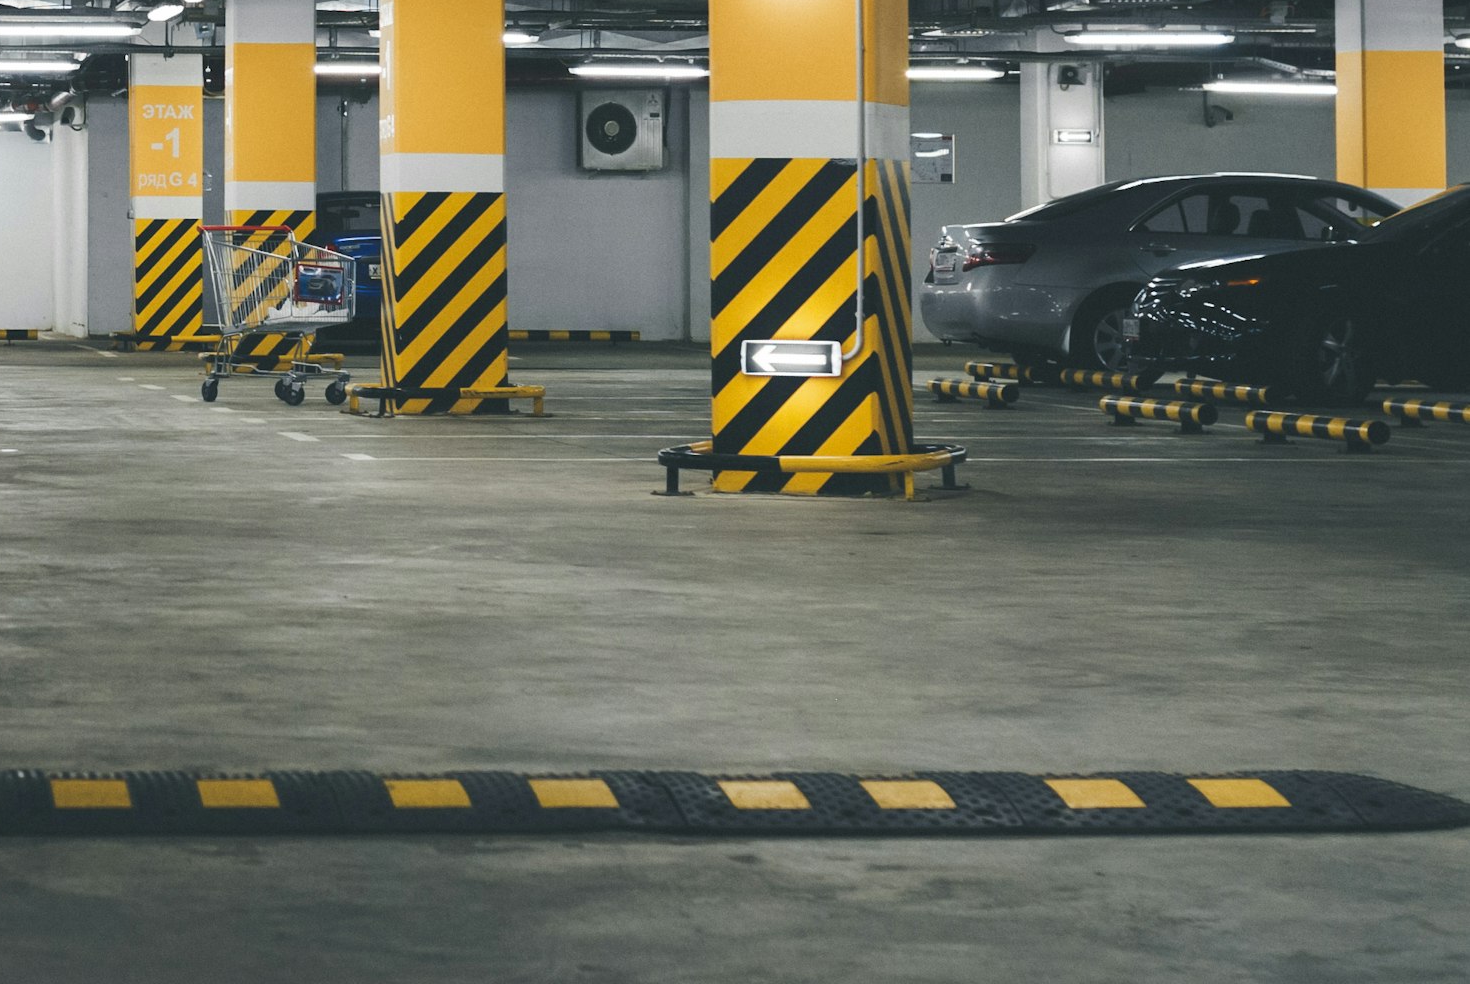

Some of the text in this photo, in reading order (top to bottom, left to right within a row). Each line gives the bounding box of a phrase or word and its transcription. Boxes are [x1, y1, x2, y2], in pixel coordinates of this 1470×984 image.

[142, 104, 195, 120] ЭТАЖ
[150, 127, 180, 158] -1
[169, 172, 182, 187] G
[187, 172, 198, 188] 4
